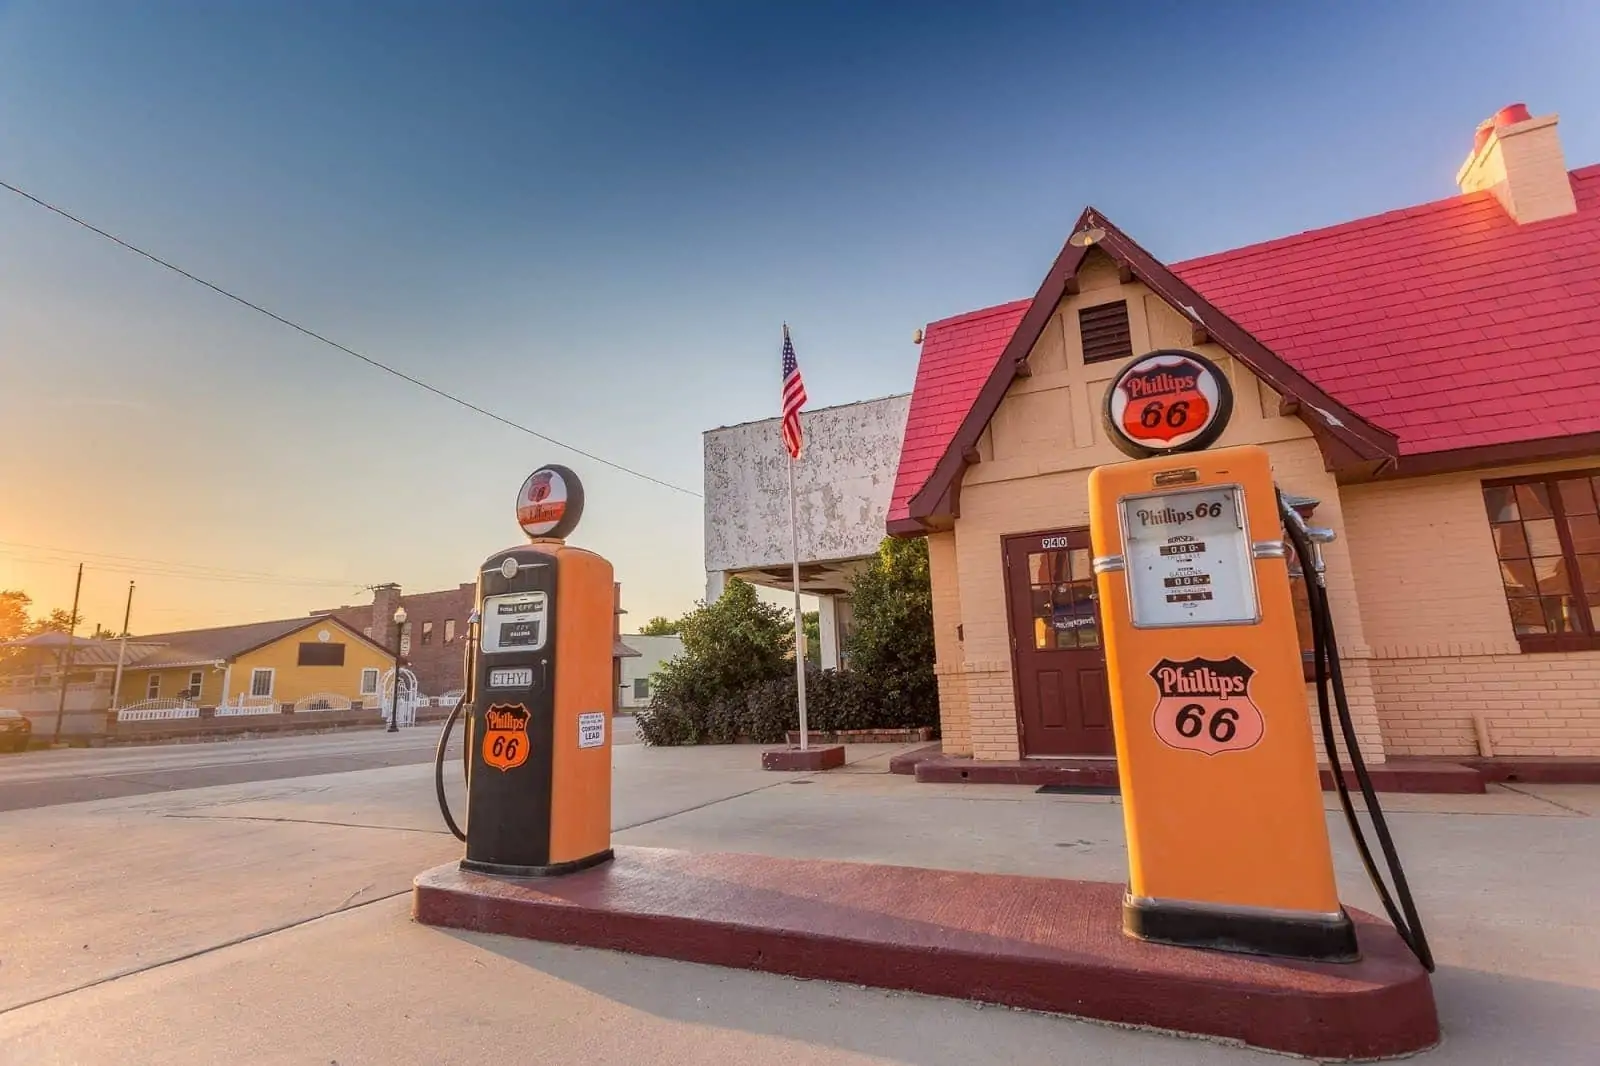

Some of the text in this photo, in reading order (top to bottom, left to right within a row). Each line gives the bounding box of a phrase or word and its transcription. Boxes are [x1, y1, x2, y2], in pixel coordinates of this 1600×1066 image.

[1128, 373, 1194, 397] Phillips
[1141, 401, 1190, 428] 66
[1137, 502, 1222, 525] Phillips 66
[1043, 537, 1066, 548] 940
[493, 672, 530, 684] ETHYL
[1157, 667, 1245, 700] Phillips
[489, 711, 524, 732] Phillips
[1175, 704, 1239, 742] 66
[585, 732, 600, 740] LEAD
[493, 736, 518, 760] 66
